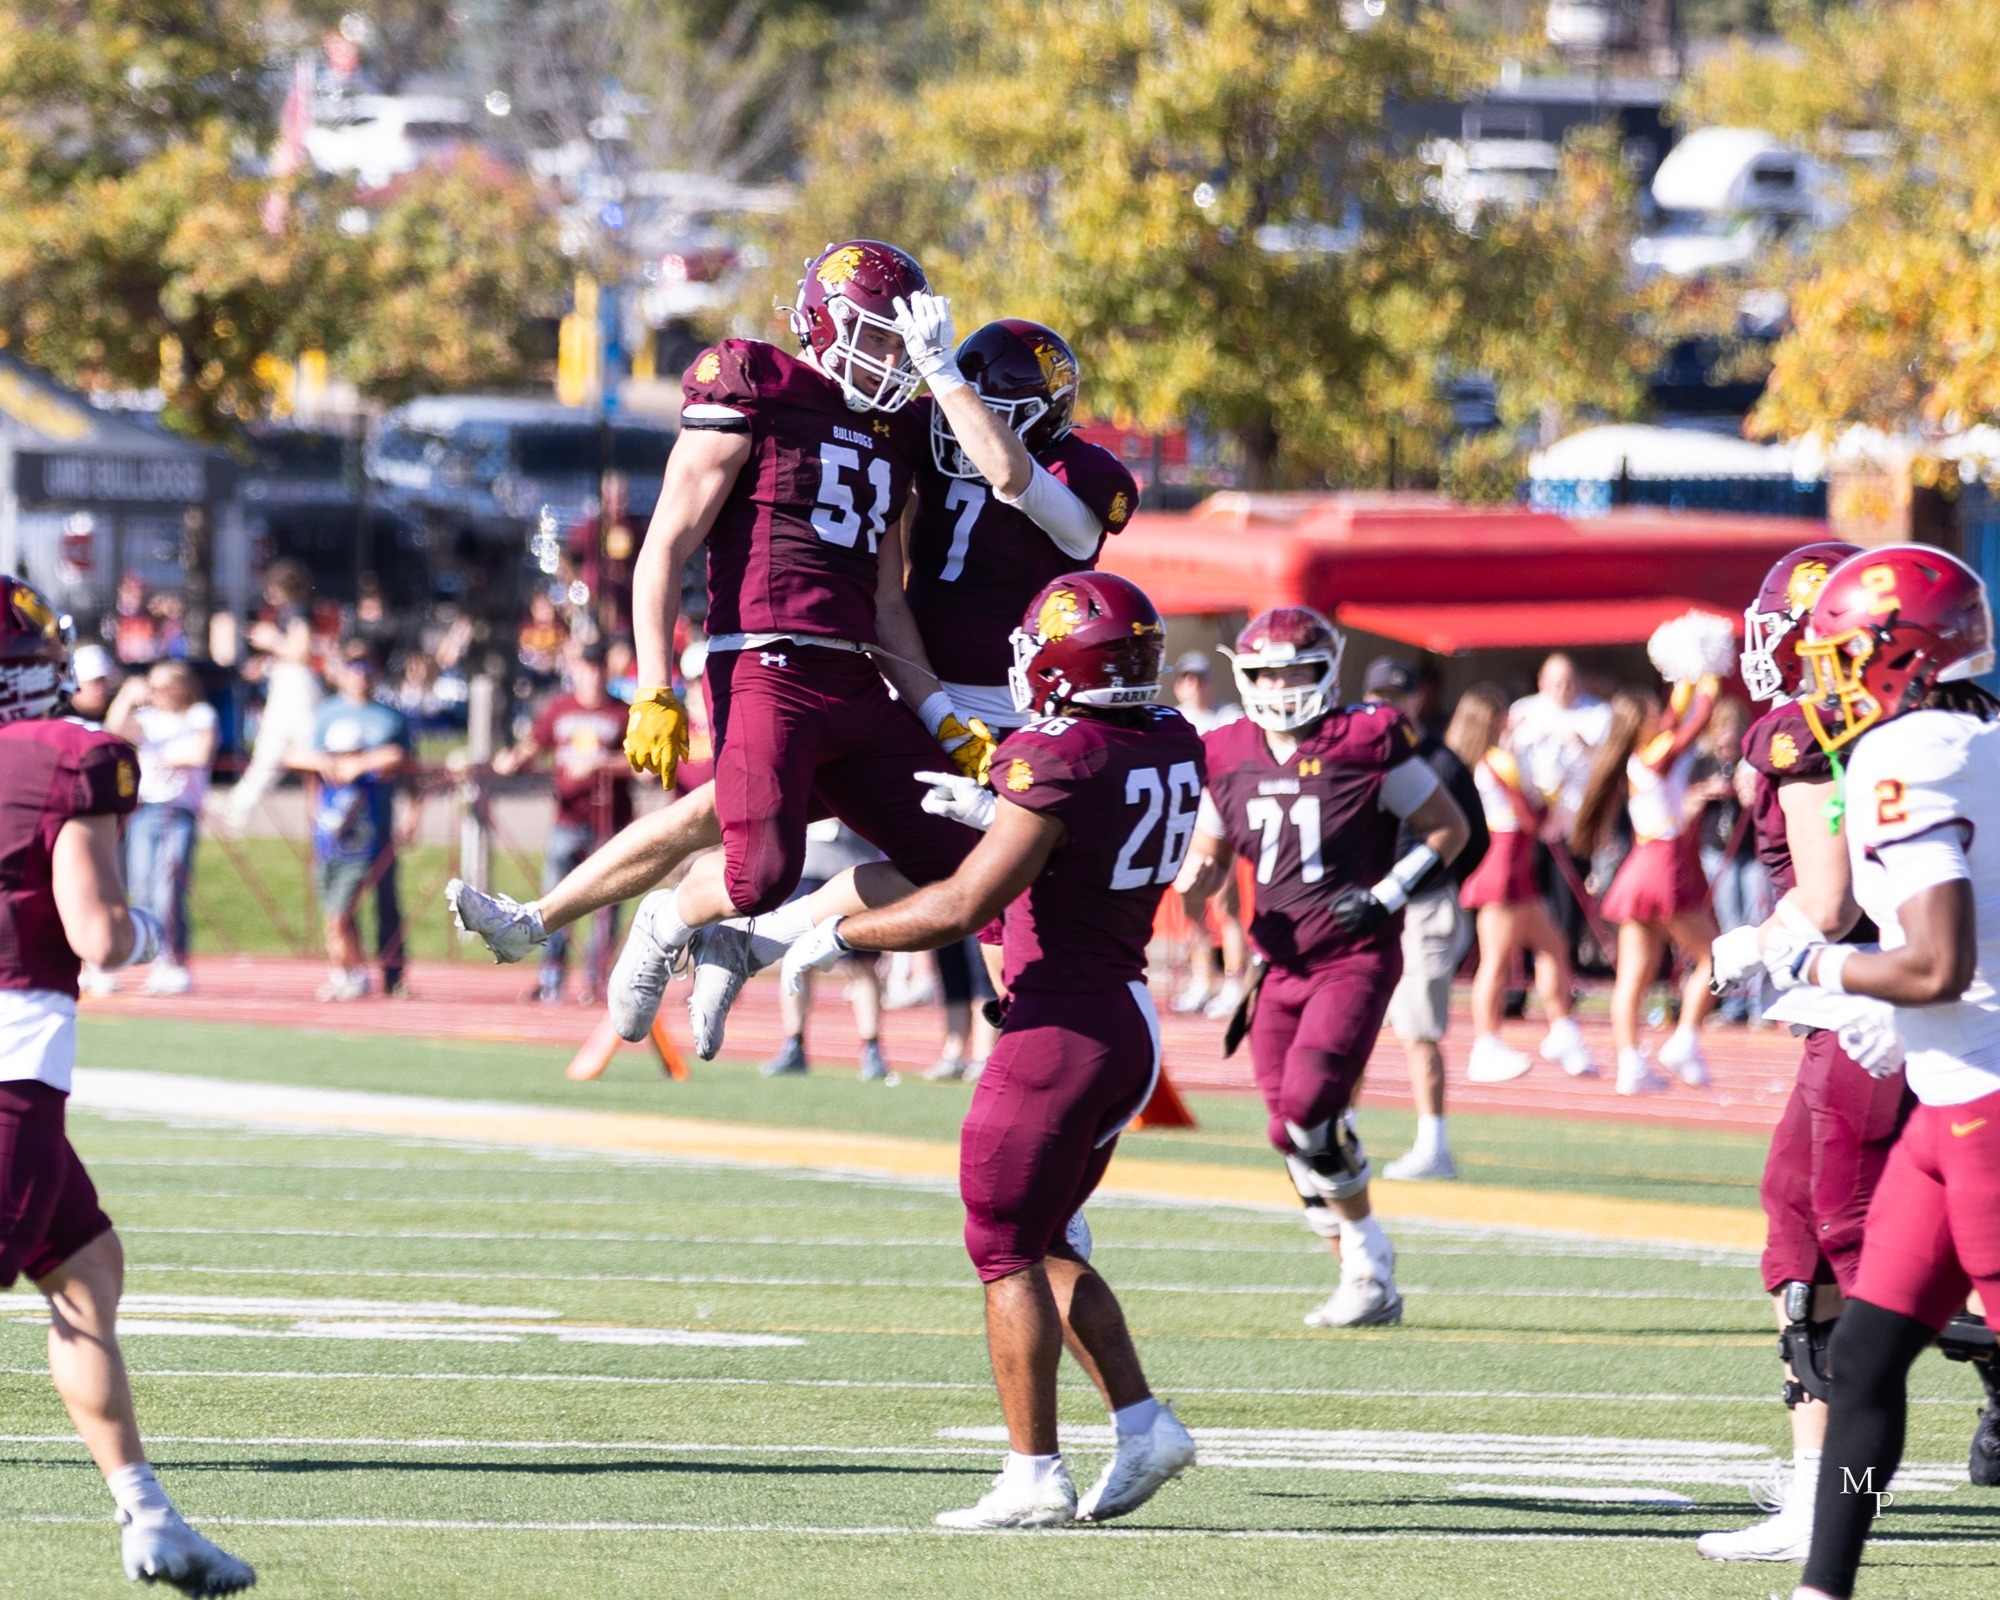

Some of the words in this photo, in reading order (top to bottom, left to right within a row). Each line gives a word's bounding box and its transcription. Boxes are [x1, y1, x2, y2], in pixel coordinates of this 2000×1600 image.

[833, 426, 873, 449] BULLDOGS
[810, 442, 890, 553] 51
[938, 479, 986, 582] 7
[1860, 564, 1901, 616] 2
[1109, 690, 1149, 704] EARN
[1109, 761, 1200, 890] 26
[1874, 778, 1908, 827] 2
[1246, 795, 1324, 885] 71
